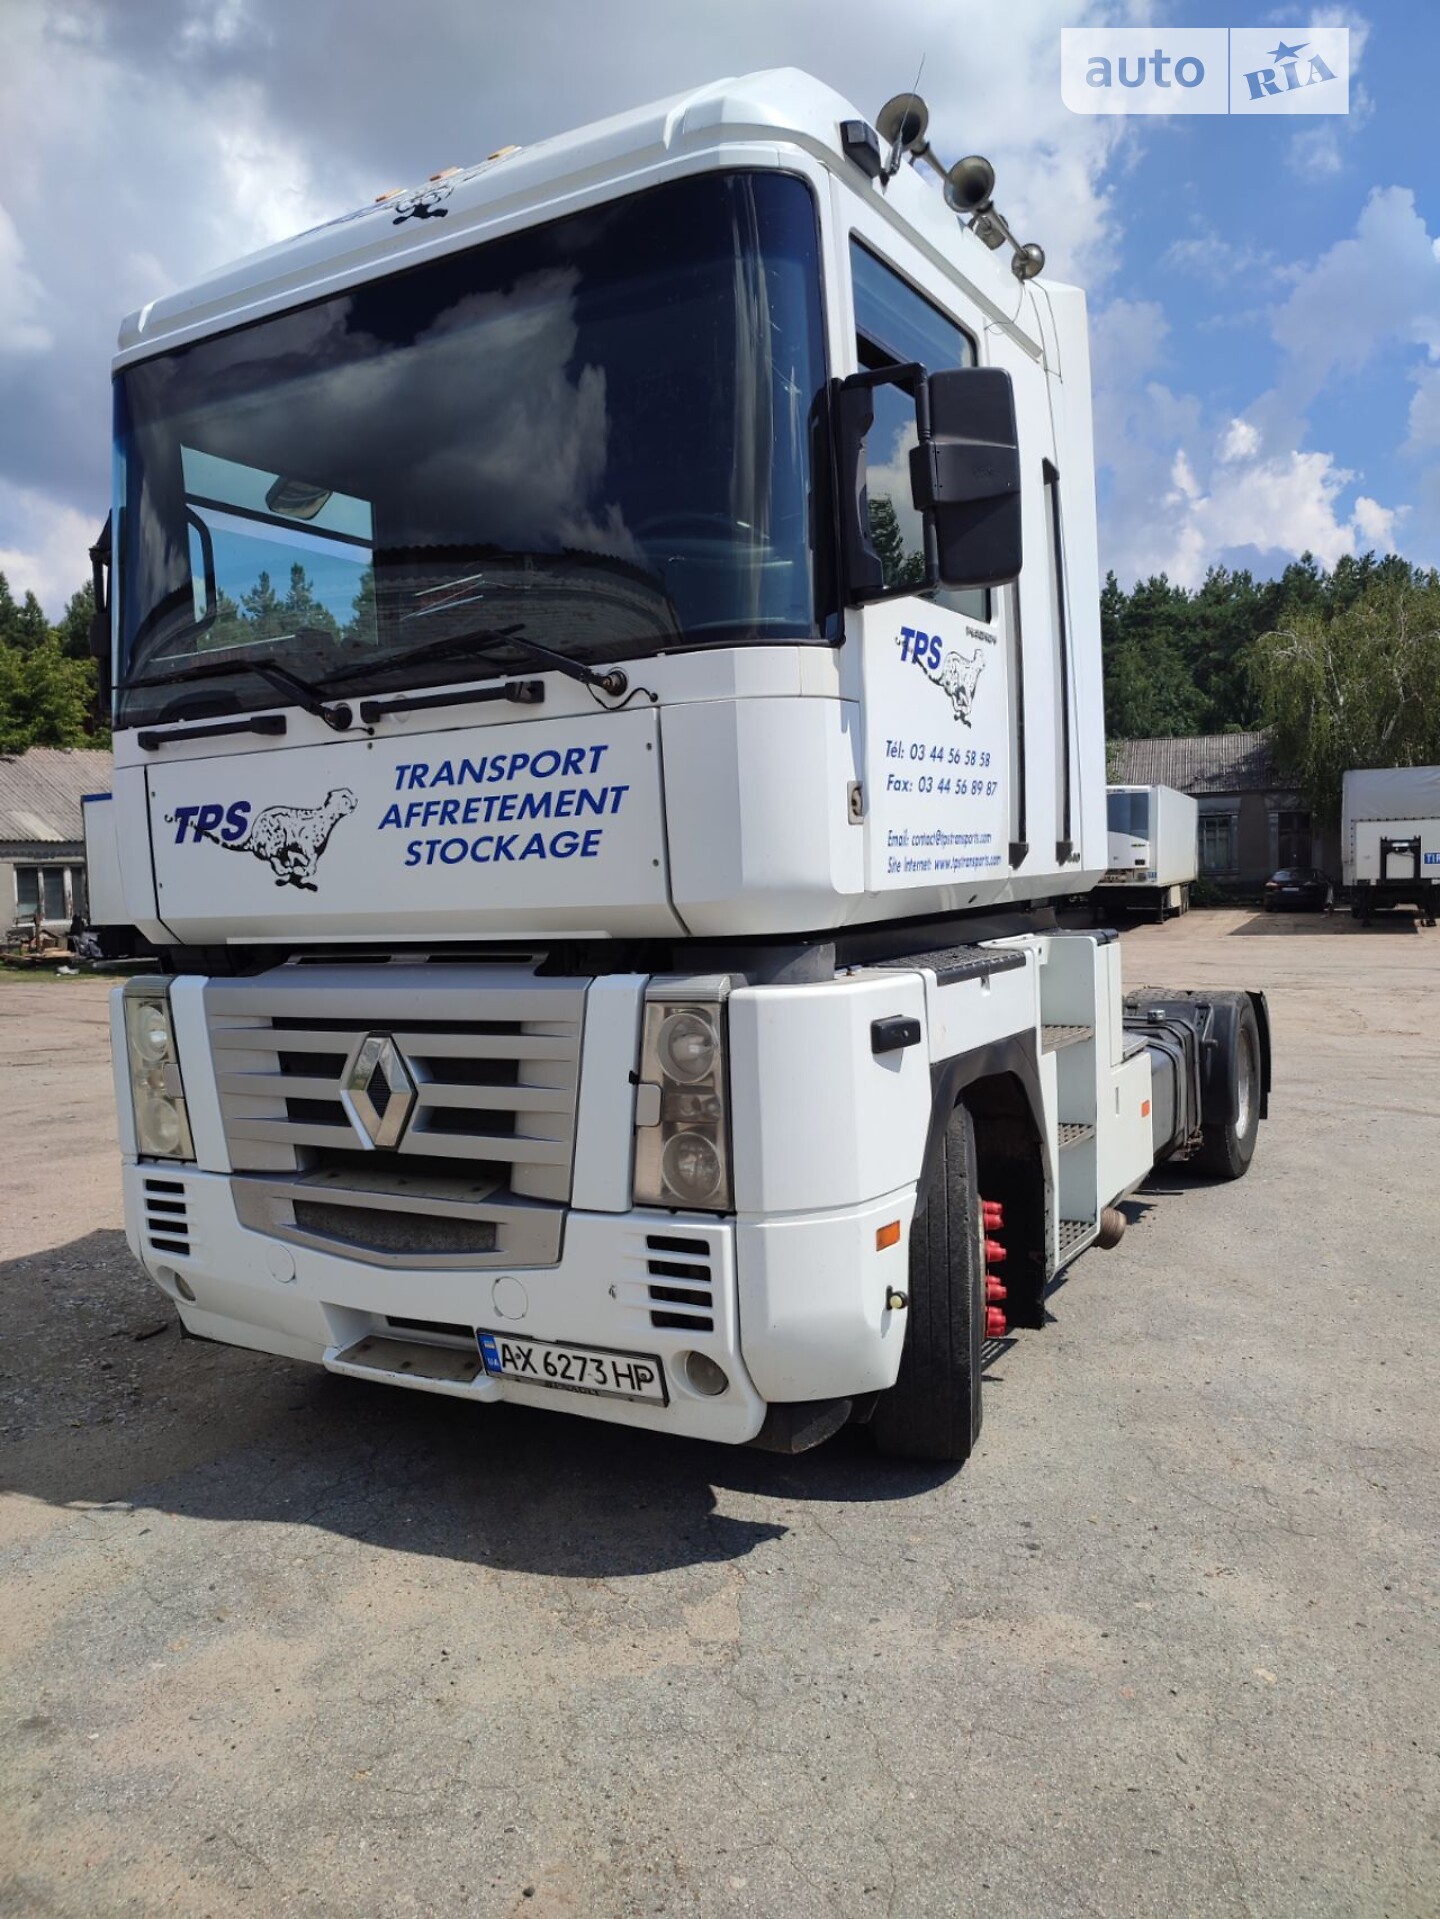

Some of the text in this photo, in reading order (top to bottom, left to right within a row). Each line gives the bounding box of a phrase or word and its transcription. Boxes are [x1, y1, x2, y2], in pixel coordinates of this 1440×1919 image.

[900, 626, 943, 670] TPS
[394, 744, 608, 791] TRANSPORT
[910, 743, 925, 761] 03
[930, 746, 944, 762] 44
[948, 748, 961, 764] 56
[964, 750, 976, 766] 58
[979, 752, 991, 767] 58
[377, 785, 629, 830] AFFRETEMENT
[886, 774, 998, 797] Fax: 03 44 56 89 87
[173, 800, 252, 844] TPS
[404, 829, 603, 866] STOCKAGE
[887, 856, 901, 873] Site
[502, 1344, 538, 1374] AX
[543, 1352, 607, 1385] 6273
[612, 1361, 655, 1391] HP
